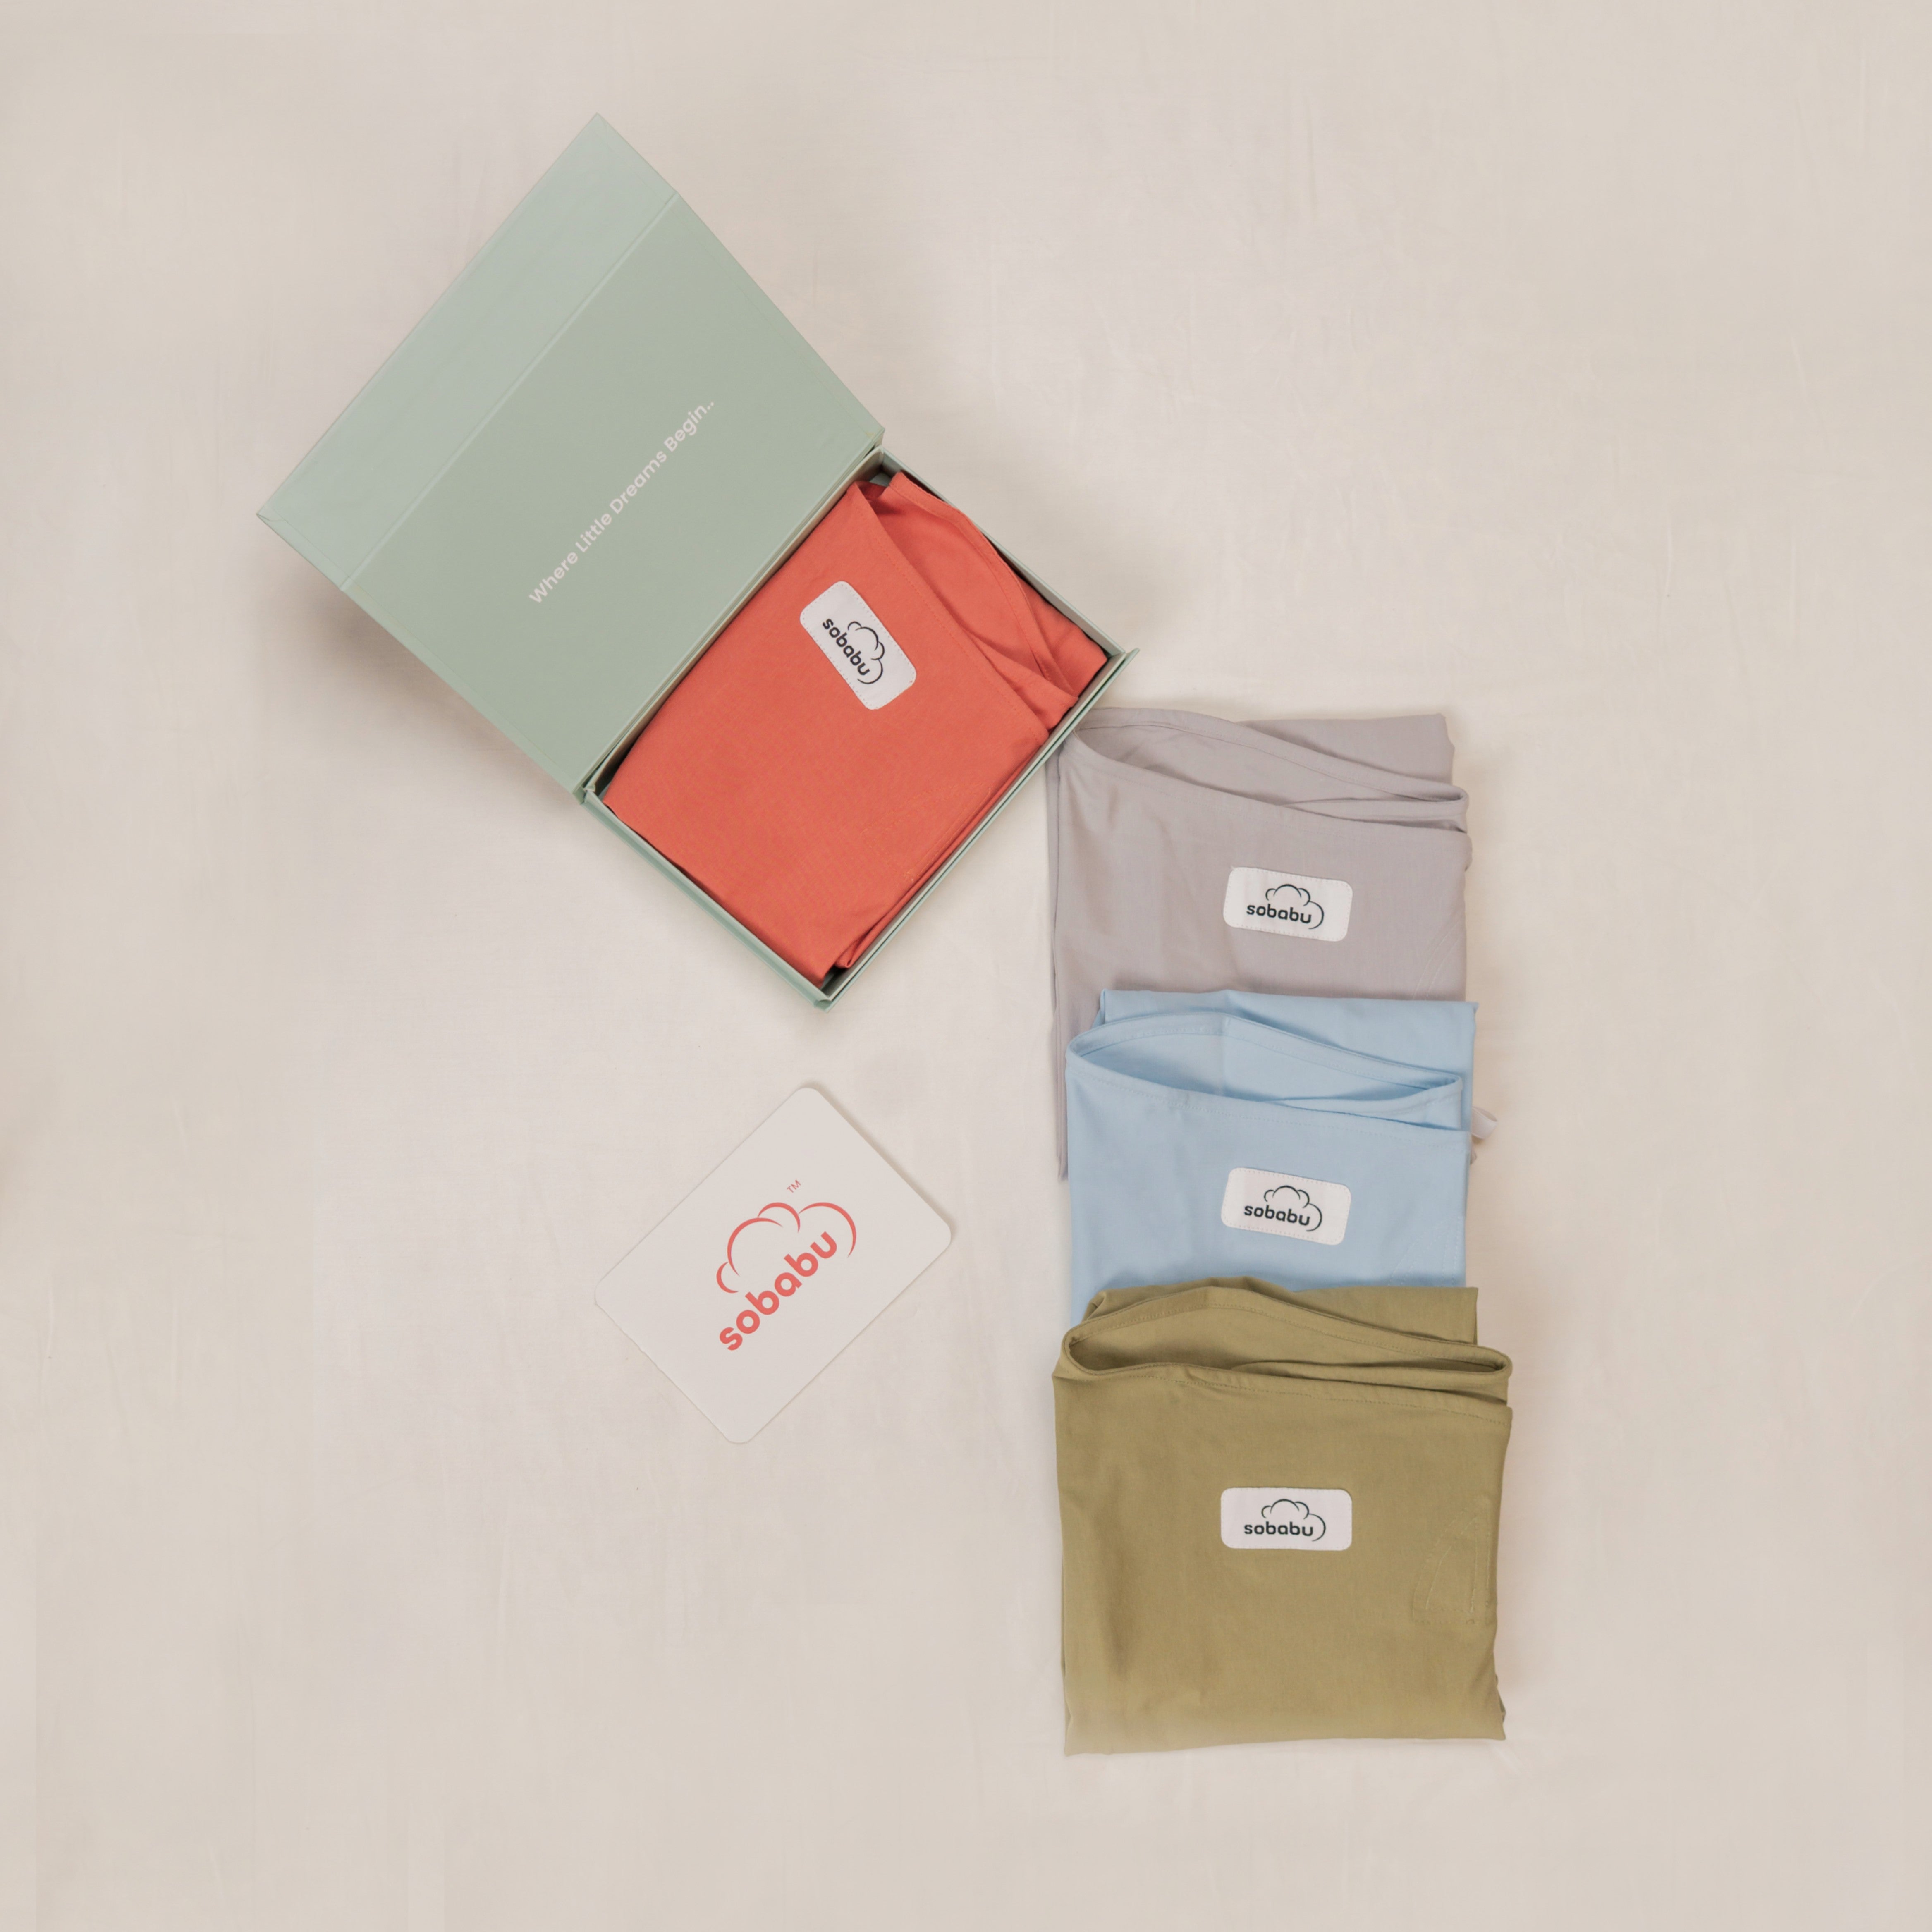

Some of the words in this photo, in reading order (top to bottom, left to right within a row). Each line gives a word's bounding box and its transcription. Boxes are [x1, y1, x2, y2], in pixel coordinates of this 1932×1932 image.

[528, 551, 578, 603] Where
[575, 513, 612, 553] Little
[609, 450, 667, 514] Dreams
[663, 402, 715, 452] Begin..
[823, 619, 870, 676] sobabu
[1246, 903, 1312, 924] sobabu
[786, 1179, 801, 1193] TM
[1243, 1204, 1310, 1226] sobabu
[719, 1231, 837, 1351] sobabu
[1243, 1521, 1313, 1537] sobabu
